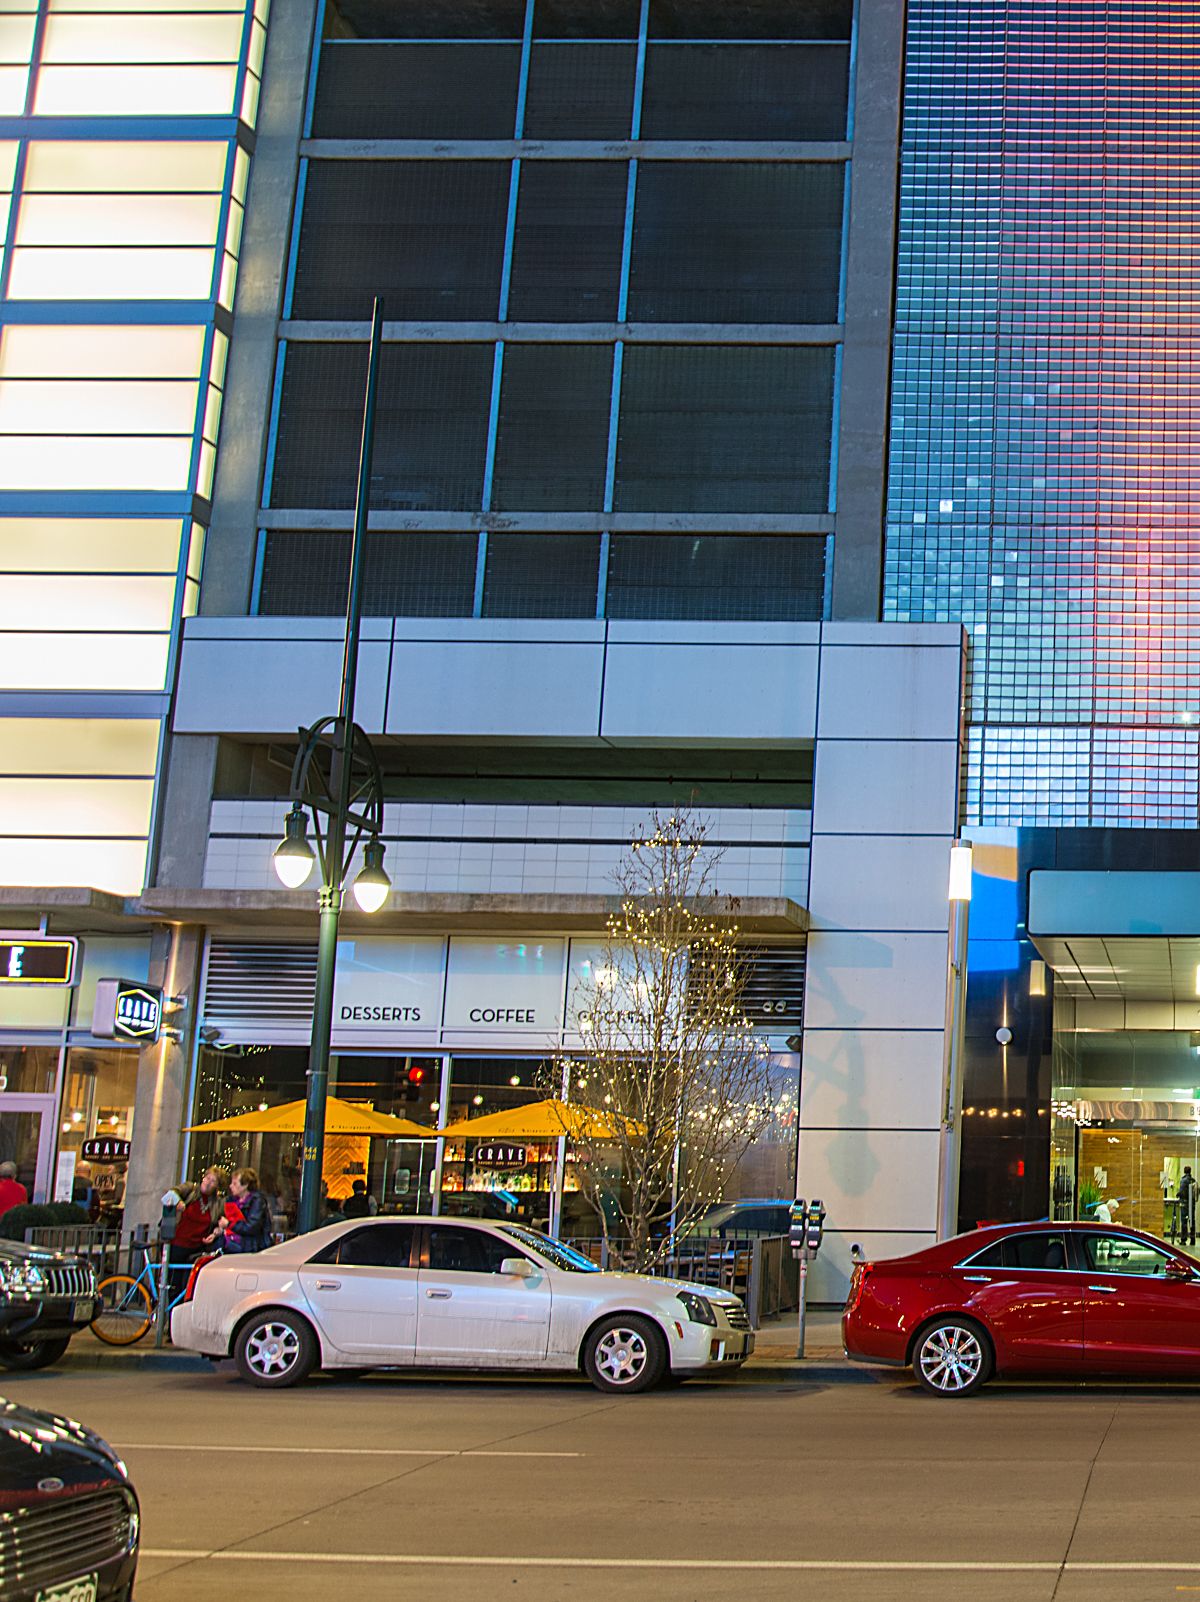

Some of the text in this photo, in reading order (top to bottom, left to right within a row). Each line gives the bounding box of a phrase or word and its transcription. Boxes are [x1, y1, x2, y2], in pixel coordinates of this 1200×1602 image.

[118, 997, 157, 1021] CRAVE
[340, 1006, 421, 1021] DESSERTS
[469, 1008, 536, 1023] COFFEE
[85, 1142, 129, 1154] CRAVE
[478, 1148, 524, 1160] CRAVE
